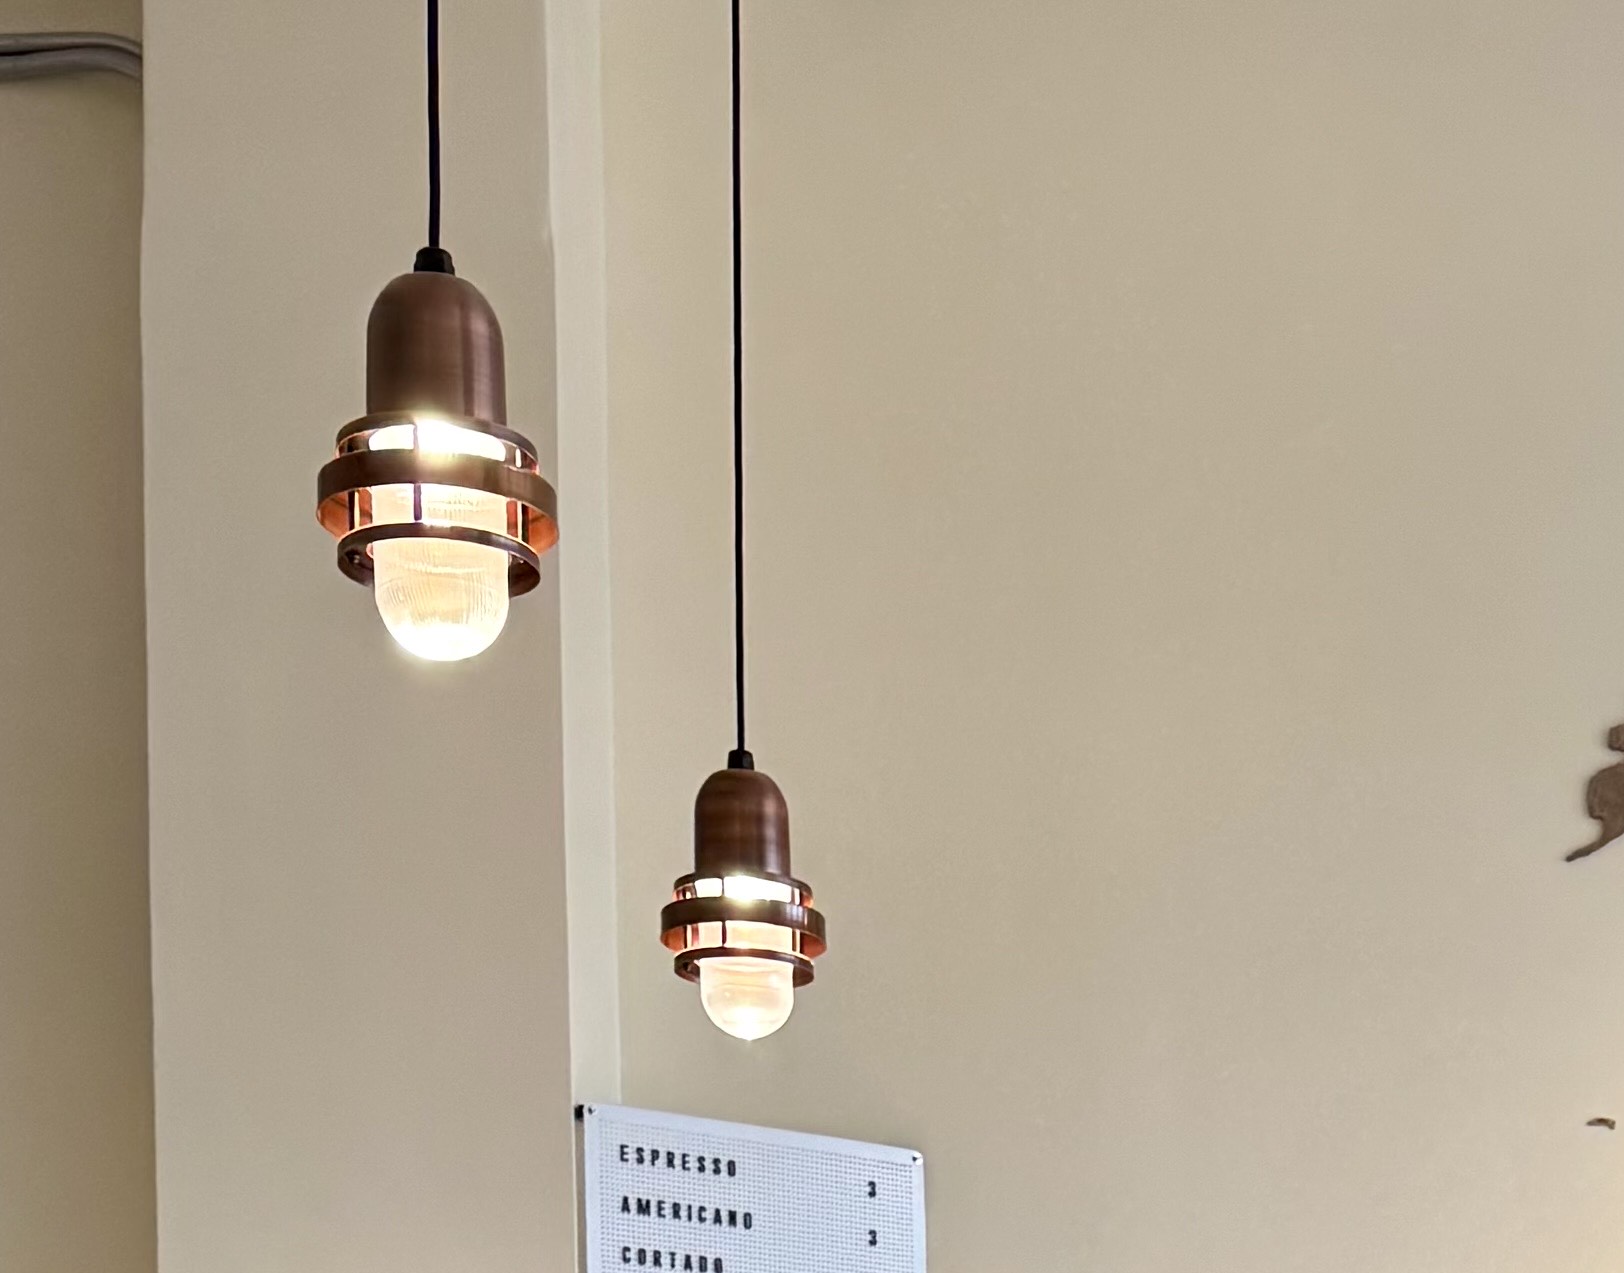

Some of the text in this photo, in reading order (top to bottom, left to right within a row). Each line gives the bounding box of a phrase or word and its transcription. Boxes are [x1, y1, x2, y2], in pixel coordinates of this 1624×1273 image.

[619, 1144, 877, 1198] ESPRESSO 3
[621, 1196, 877, 1247] AMERICANO 3
